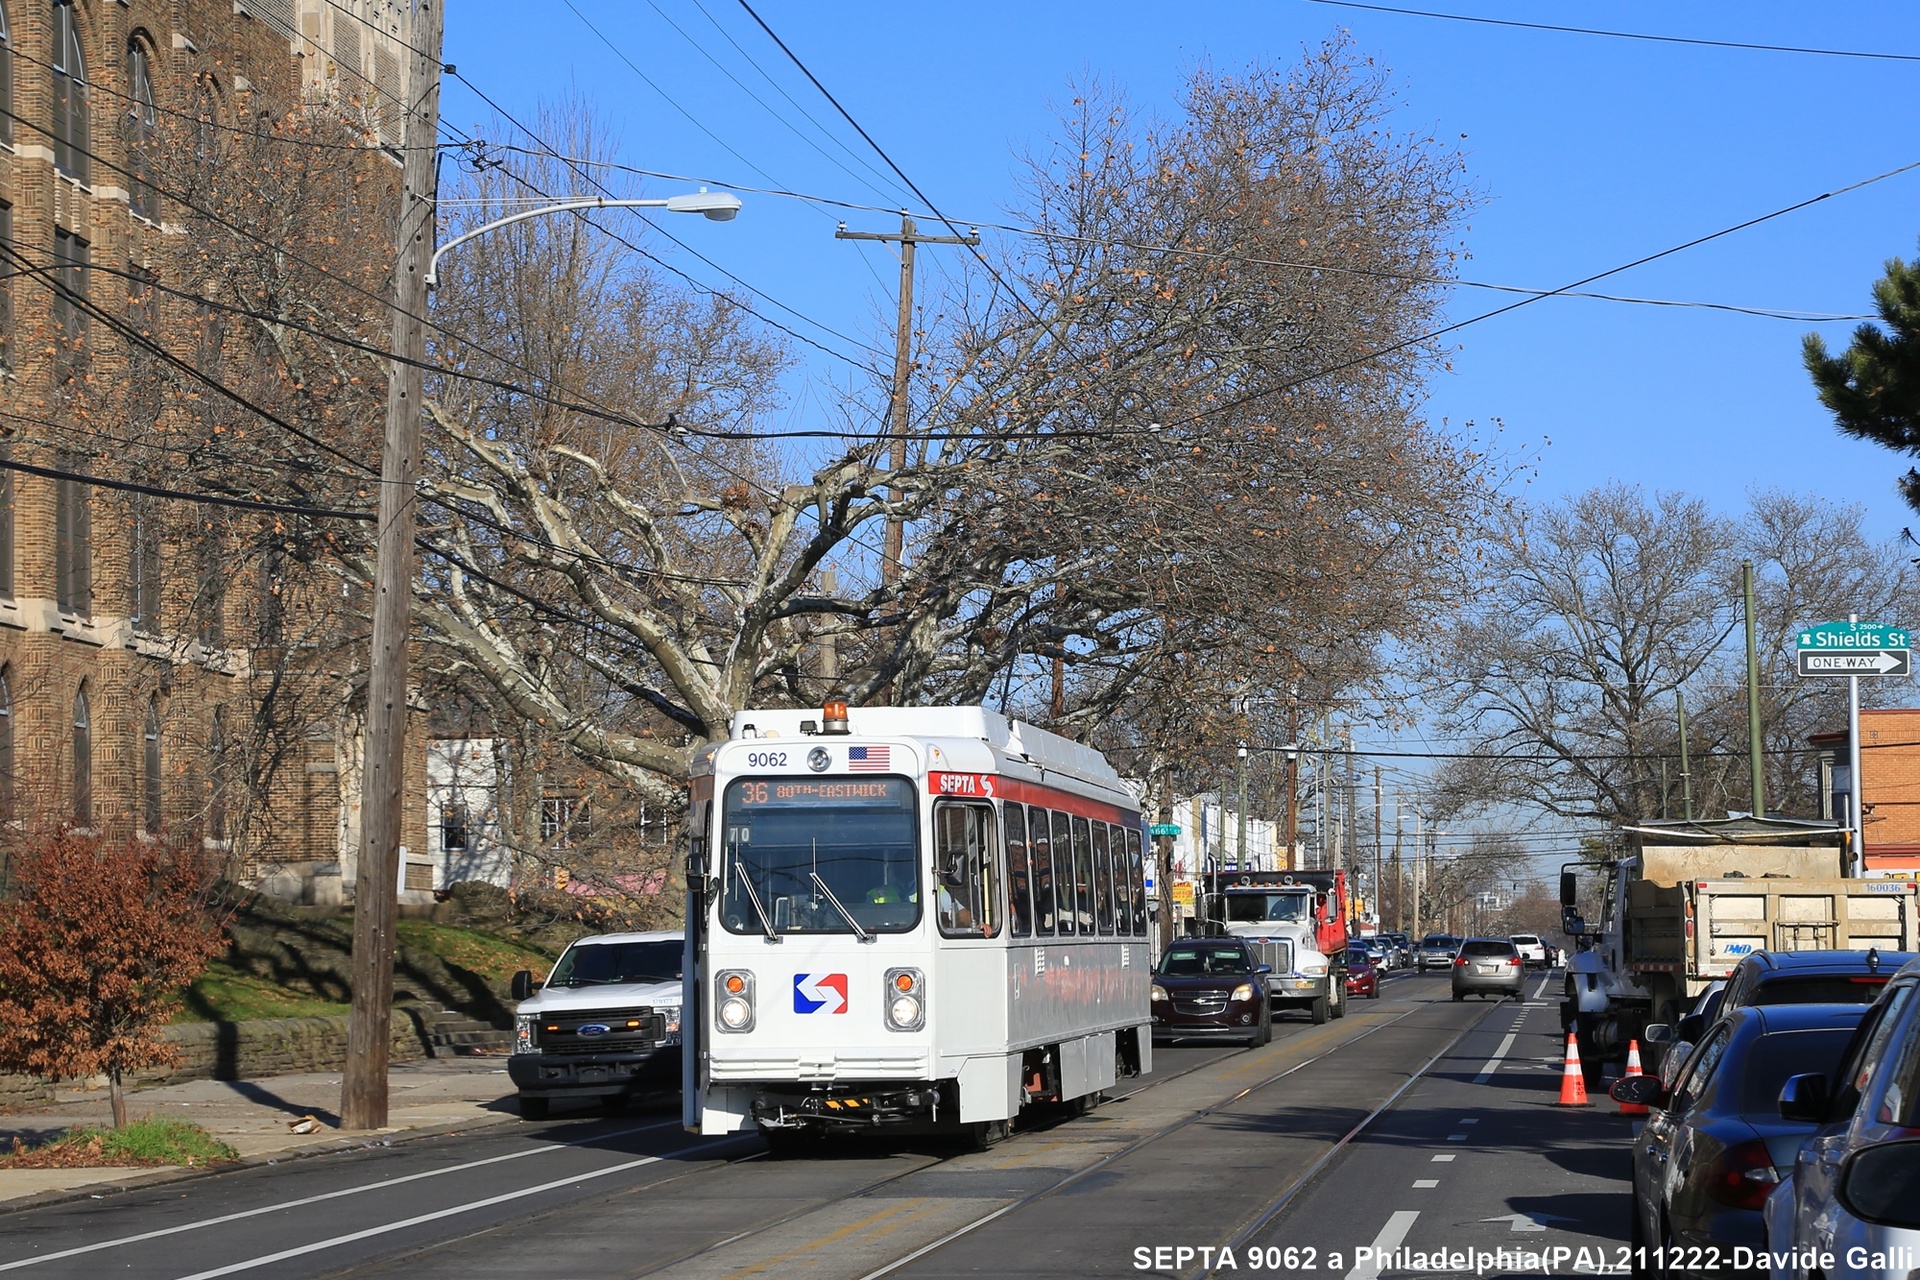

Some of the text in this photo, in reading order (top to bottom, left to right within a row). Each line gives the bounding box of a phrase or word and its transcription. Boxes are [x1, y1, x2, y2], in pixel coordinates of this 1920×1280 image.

[1850, 623, 1857, 632] S
[1815, 631, 1906, 647] Shields St
[1812, 657, 1876, 668] ONE WAY
[747, 752, 788, 767] 9062
[939, 774, 976, 794] SEPTA
[741, 781, 769, 804] 36
[1865, 883, 1901, 892] 160036
